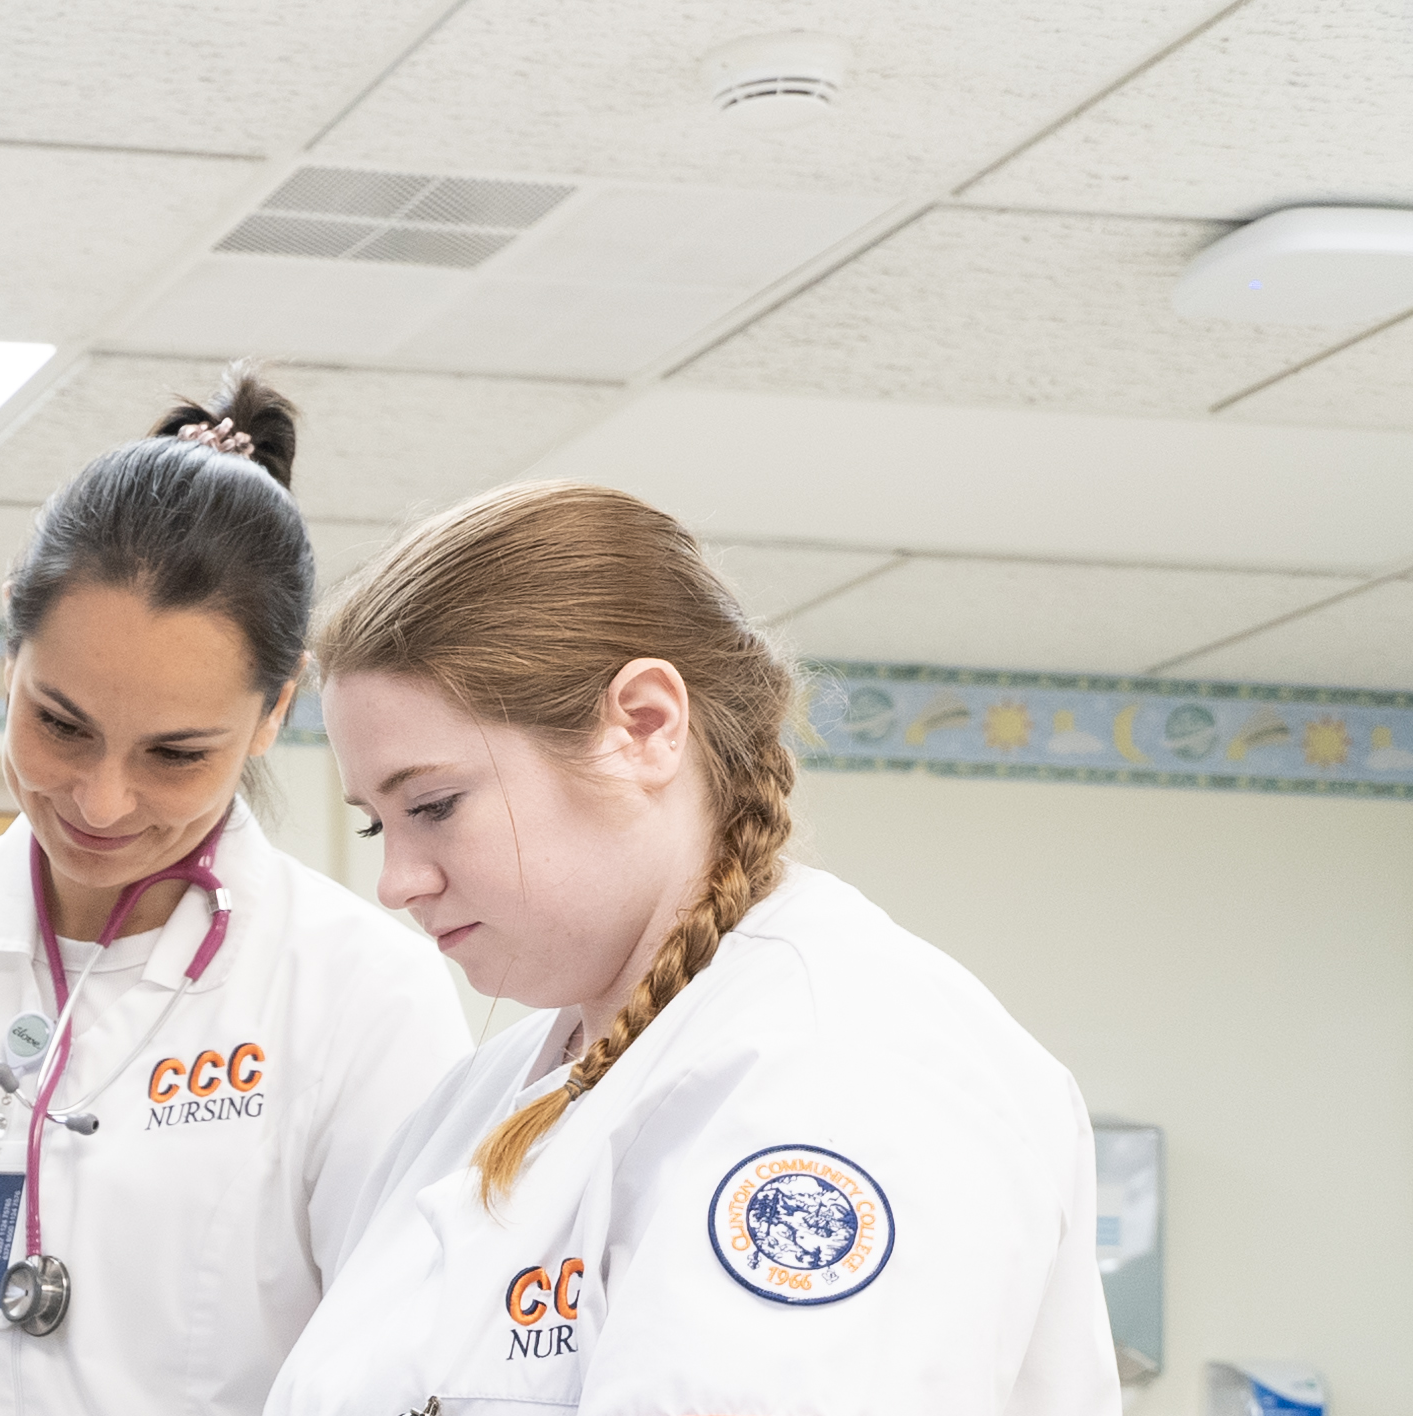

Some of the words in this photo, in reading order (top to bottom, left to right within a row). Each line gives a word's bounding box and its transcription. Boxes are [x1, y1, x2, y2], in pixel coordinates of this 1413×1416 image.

[148, 1042, 265, 1104] CCC
[144, 1093, 264, 1130] NURSING
[755, 1158, 864, 1198] COMMUNITY
[728, 1179, 756, 1252] CLINTON
[841, 1199, 876, 1274] COLLEGE
[506, 1257, 584, 1326] CC
[766, 1265, 813, 1291] 1966
